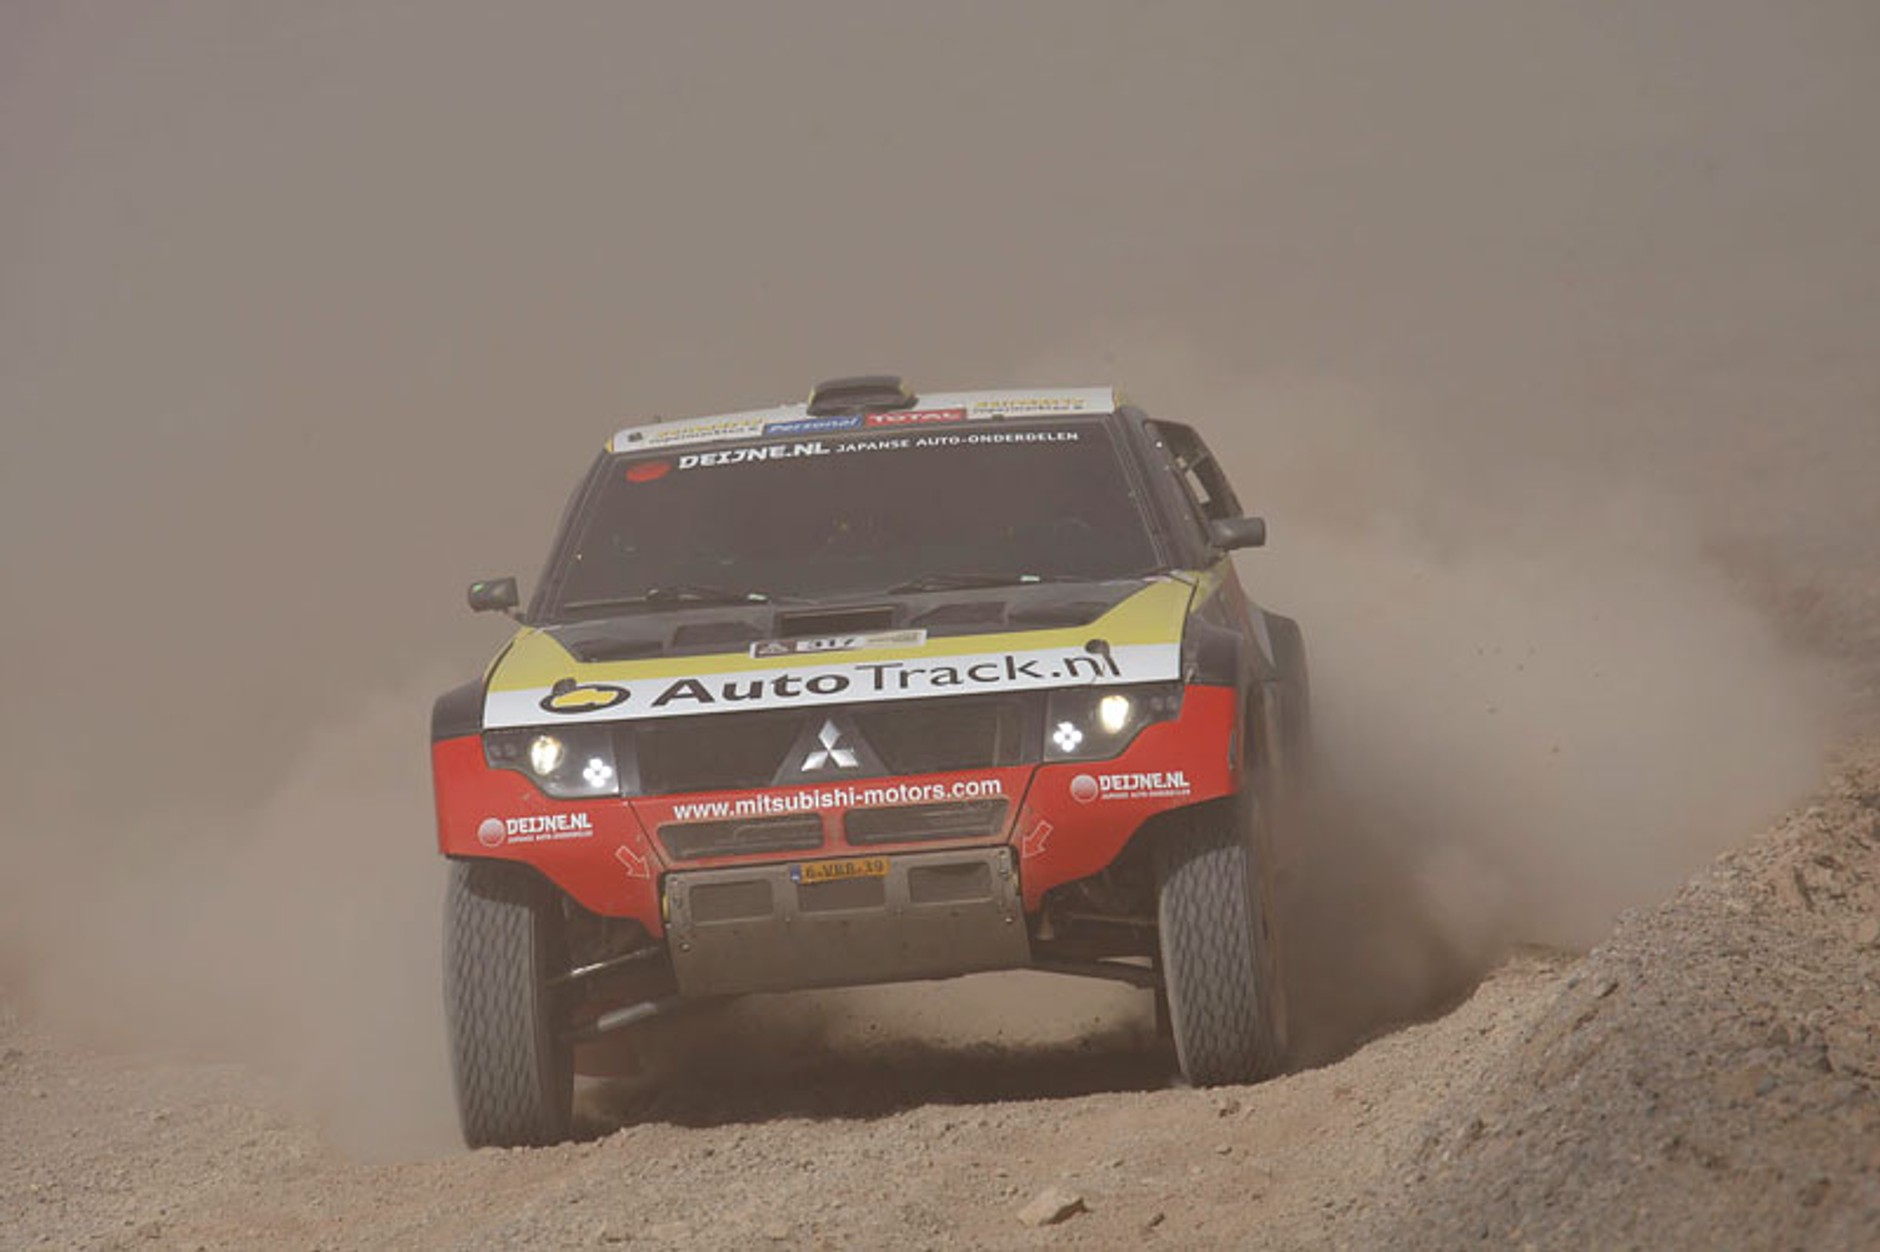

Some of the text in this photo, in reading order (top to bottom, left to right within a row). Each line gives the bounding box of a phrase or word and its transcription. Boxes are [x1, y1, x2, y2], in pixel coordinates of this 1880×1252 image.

[869, 411, 961, 424] TOTAL
[678, 431, 1079, 469] DEIJNE.NL JAPANSE AUTO-ONDERDELEN
[1098, 770, 1190, 791] DEIJNE.NL
[673, 779, 1002, 821] www.mitsubishi-motors.com
[506, 812, 593, 835] DEIJNE.NL
